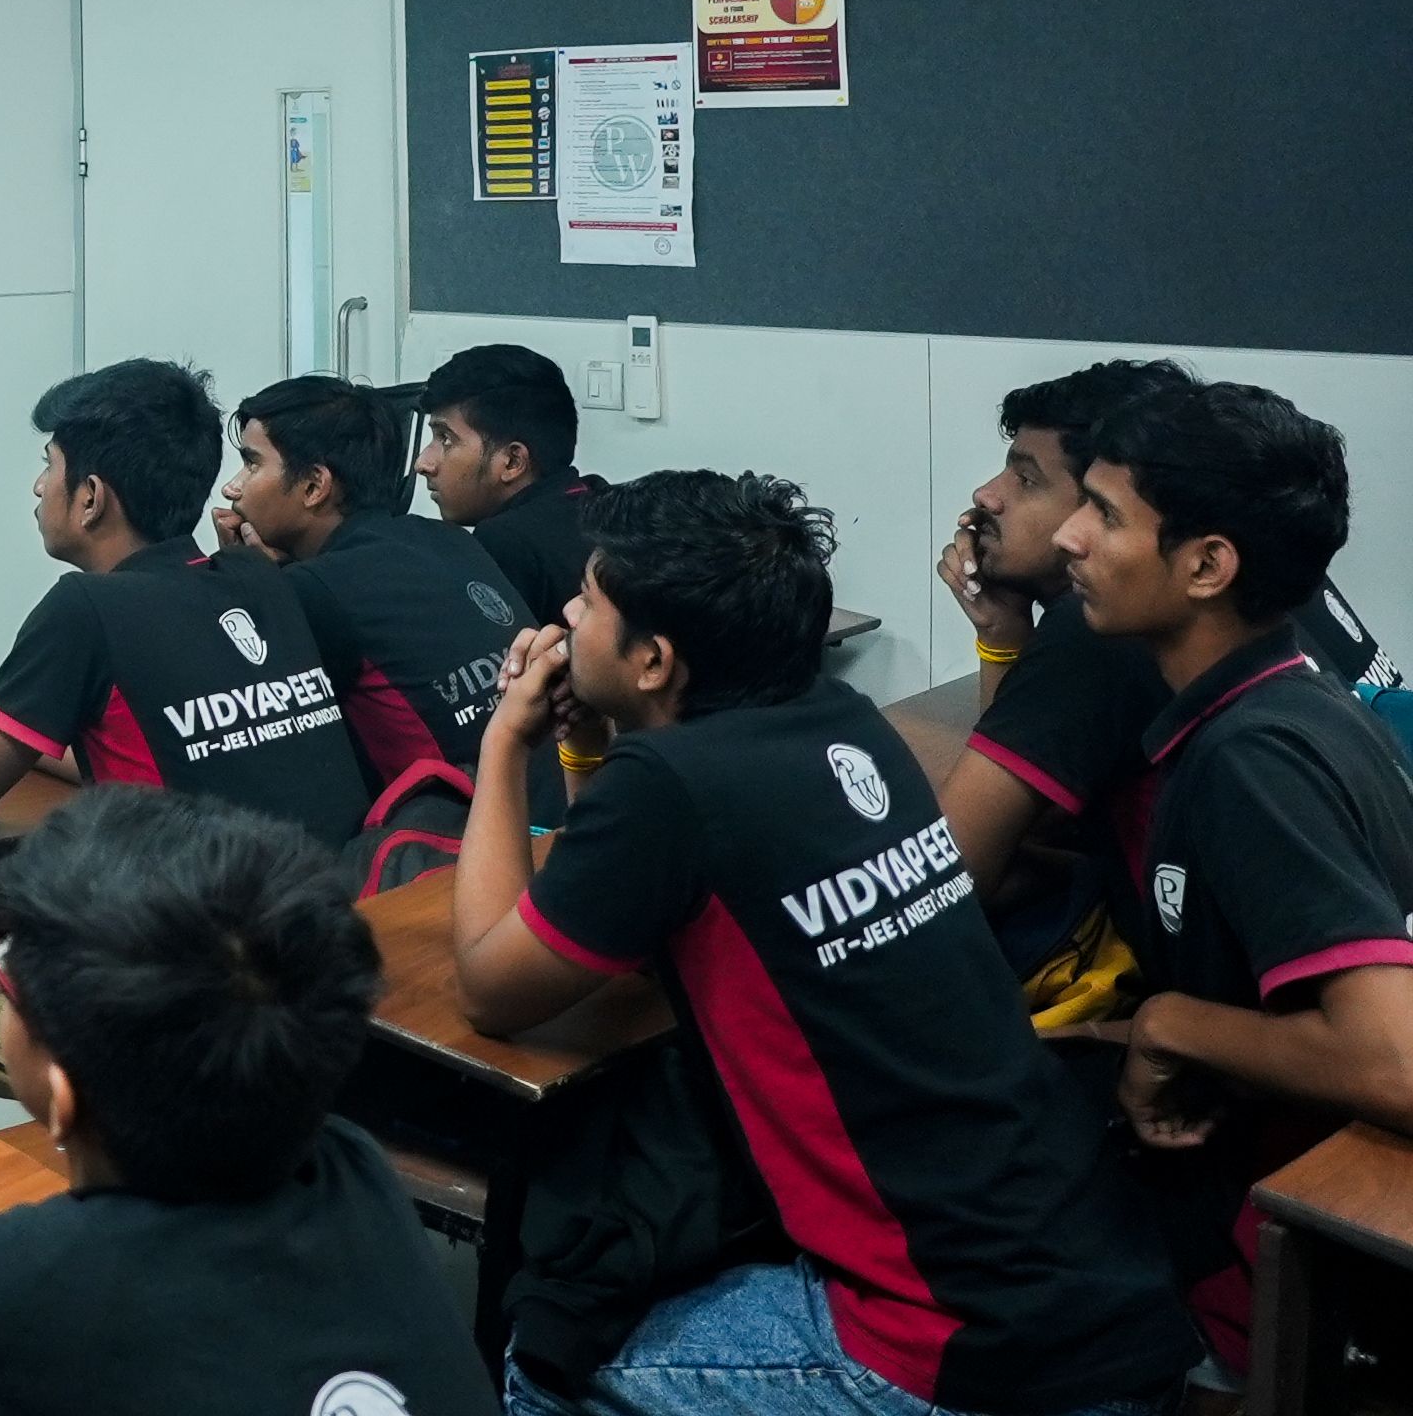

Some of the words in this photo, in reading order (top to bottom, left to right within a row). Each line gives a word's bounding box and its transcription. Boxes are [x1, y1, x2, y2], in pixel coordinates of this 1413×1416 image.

[708, 14, 759, 26] SCHOLARSHIP
[255, 718, 294, 742] NEET
[780, 815, 962, 939] VIDYAPEET
